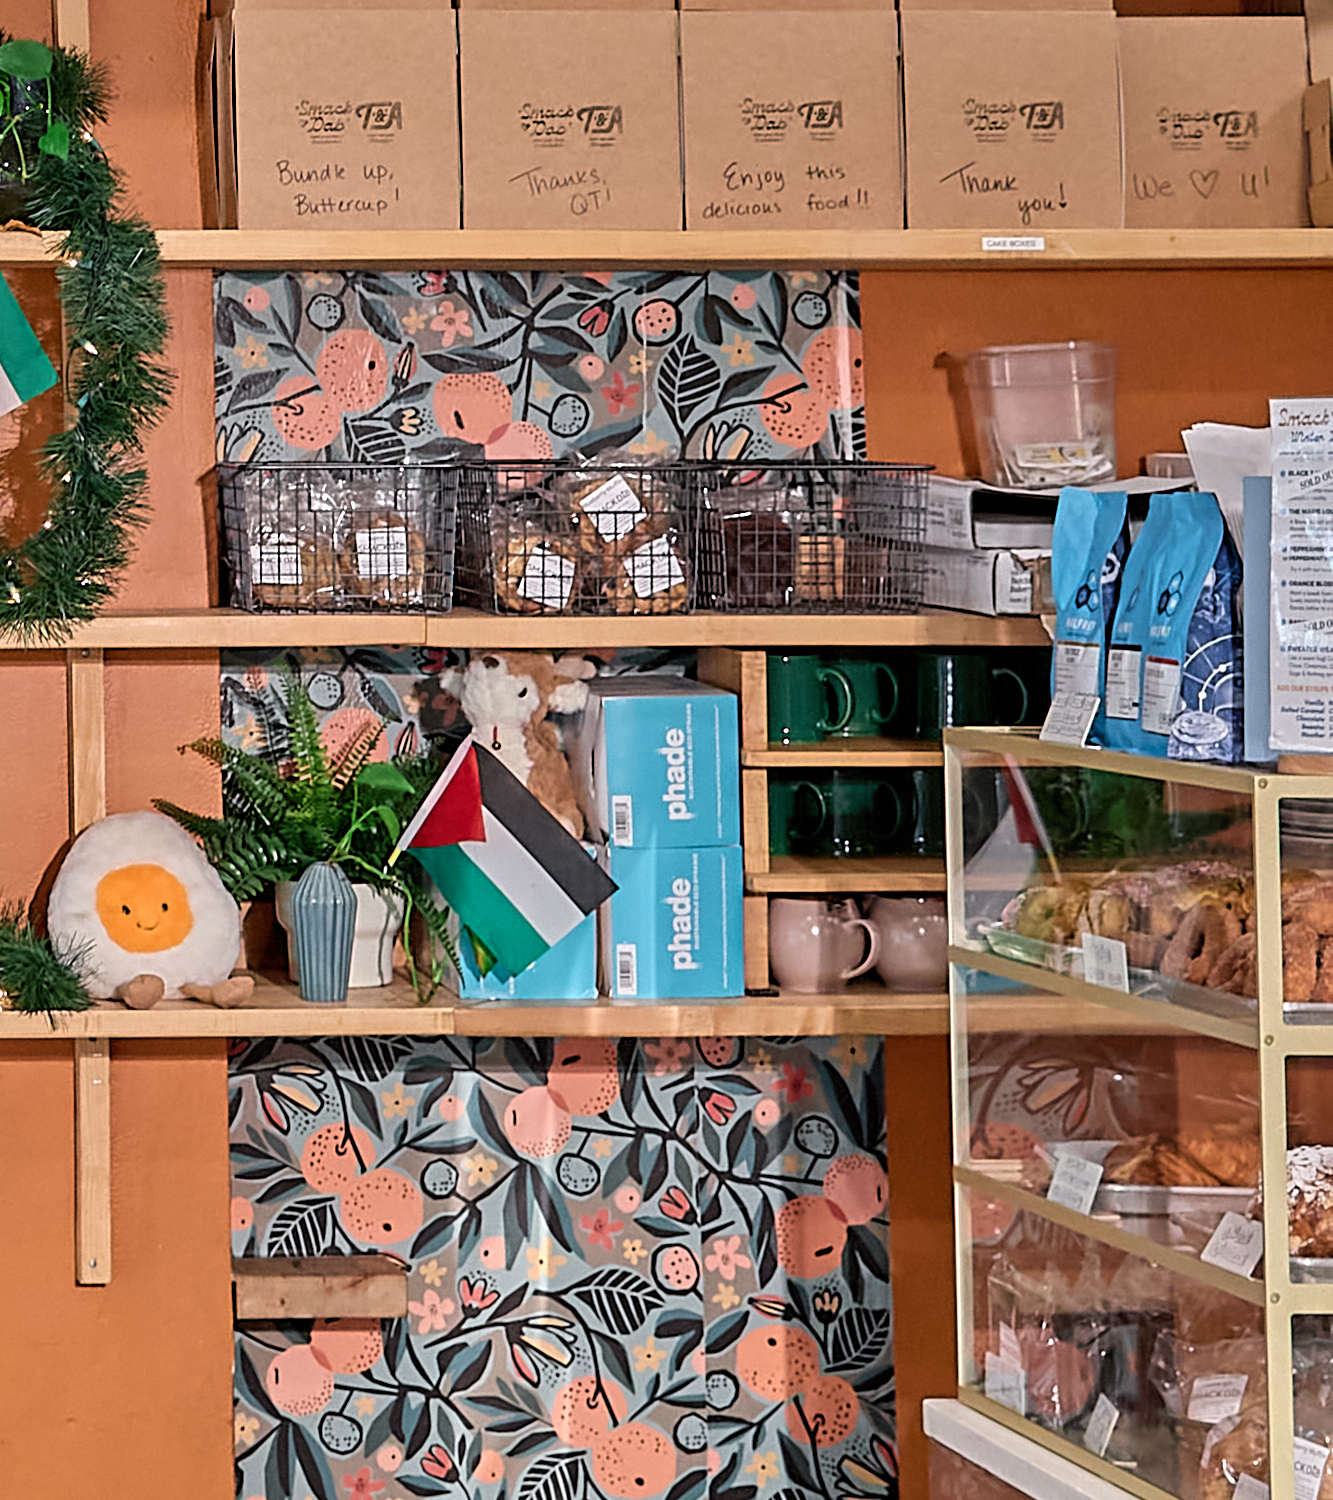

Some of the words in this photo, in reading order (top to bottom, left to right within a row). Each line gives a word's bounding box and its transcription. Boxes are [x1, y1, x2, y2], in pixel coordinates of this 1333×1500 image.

[276, 159, 346, 185] Bundle
[723, 162, 785, 193] Enjoy
[805, 164, 846, 180] this
[939, 161, 1019, 194] Thank
[1133, 172, 1176, 200] We
[294, 187, 399, 216] Buttercup!
[702, 201, 782, 220] delicious
[986, 240, 1007, 248] CAKE
[656, 728, 697, 819] phade
[661, 878, 702, 970] phade
